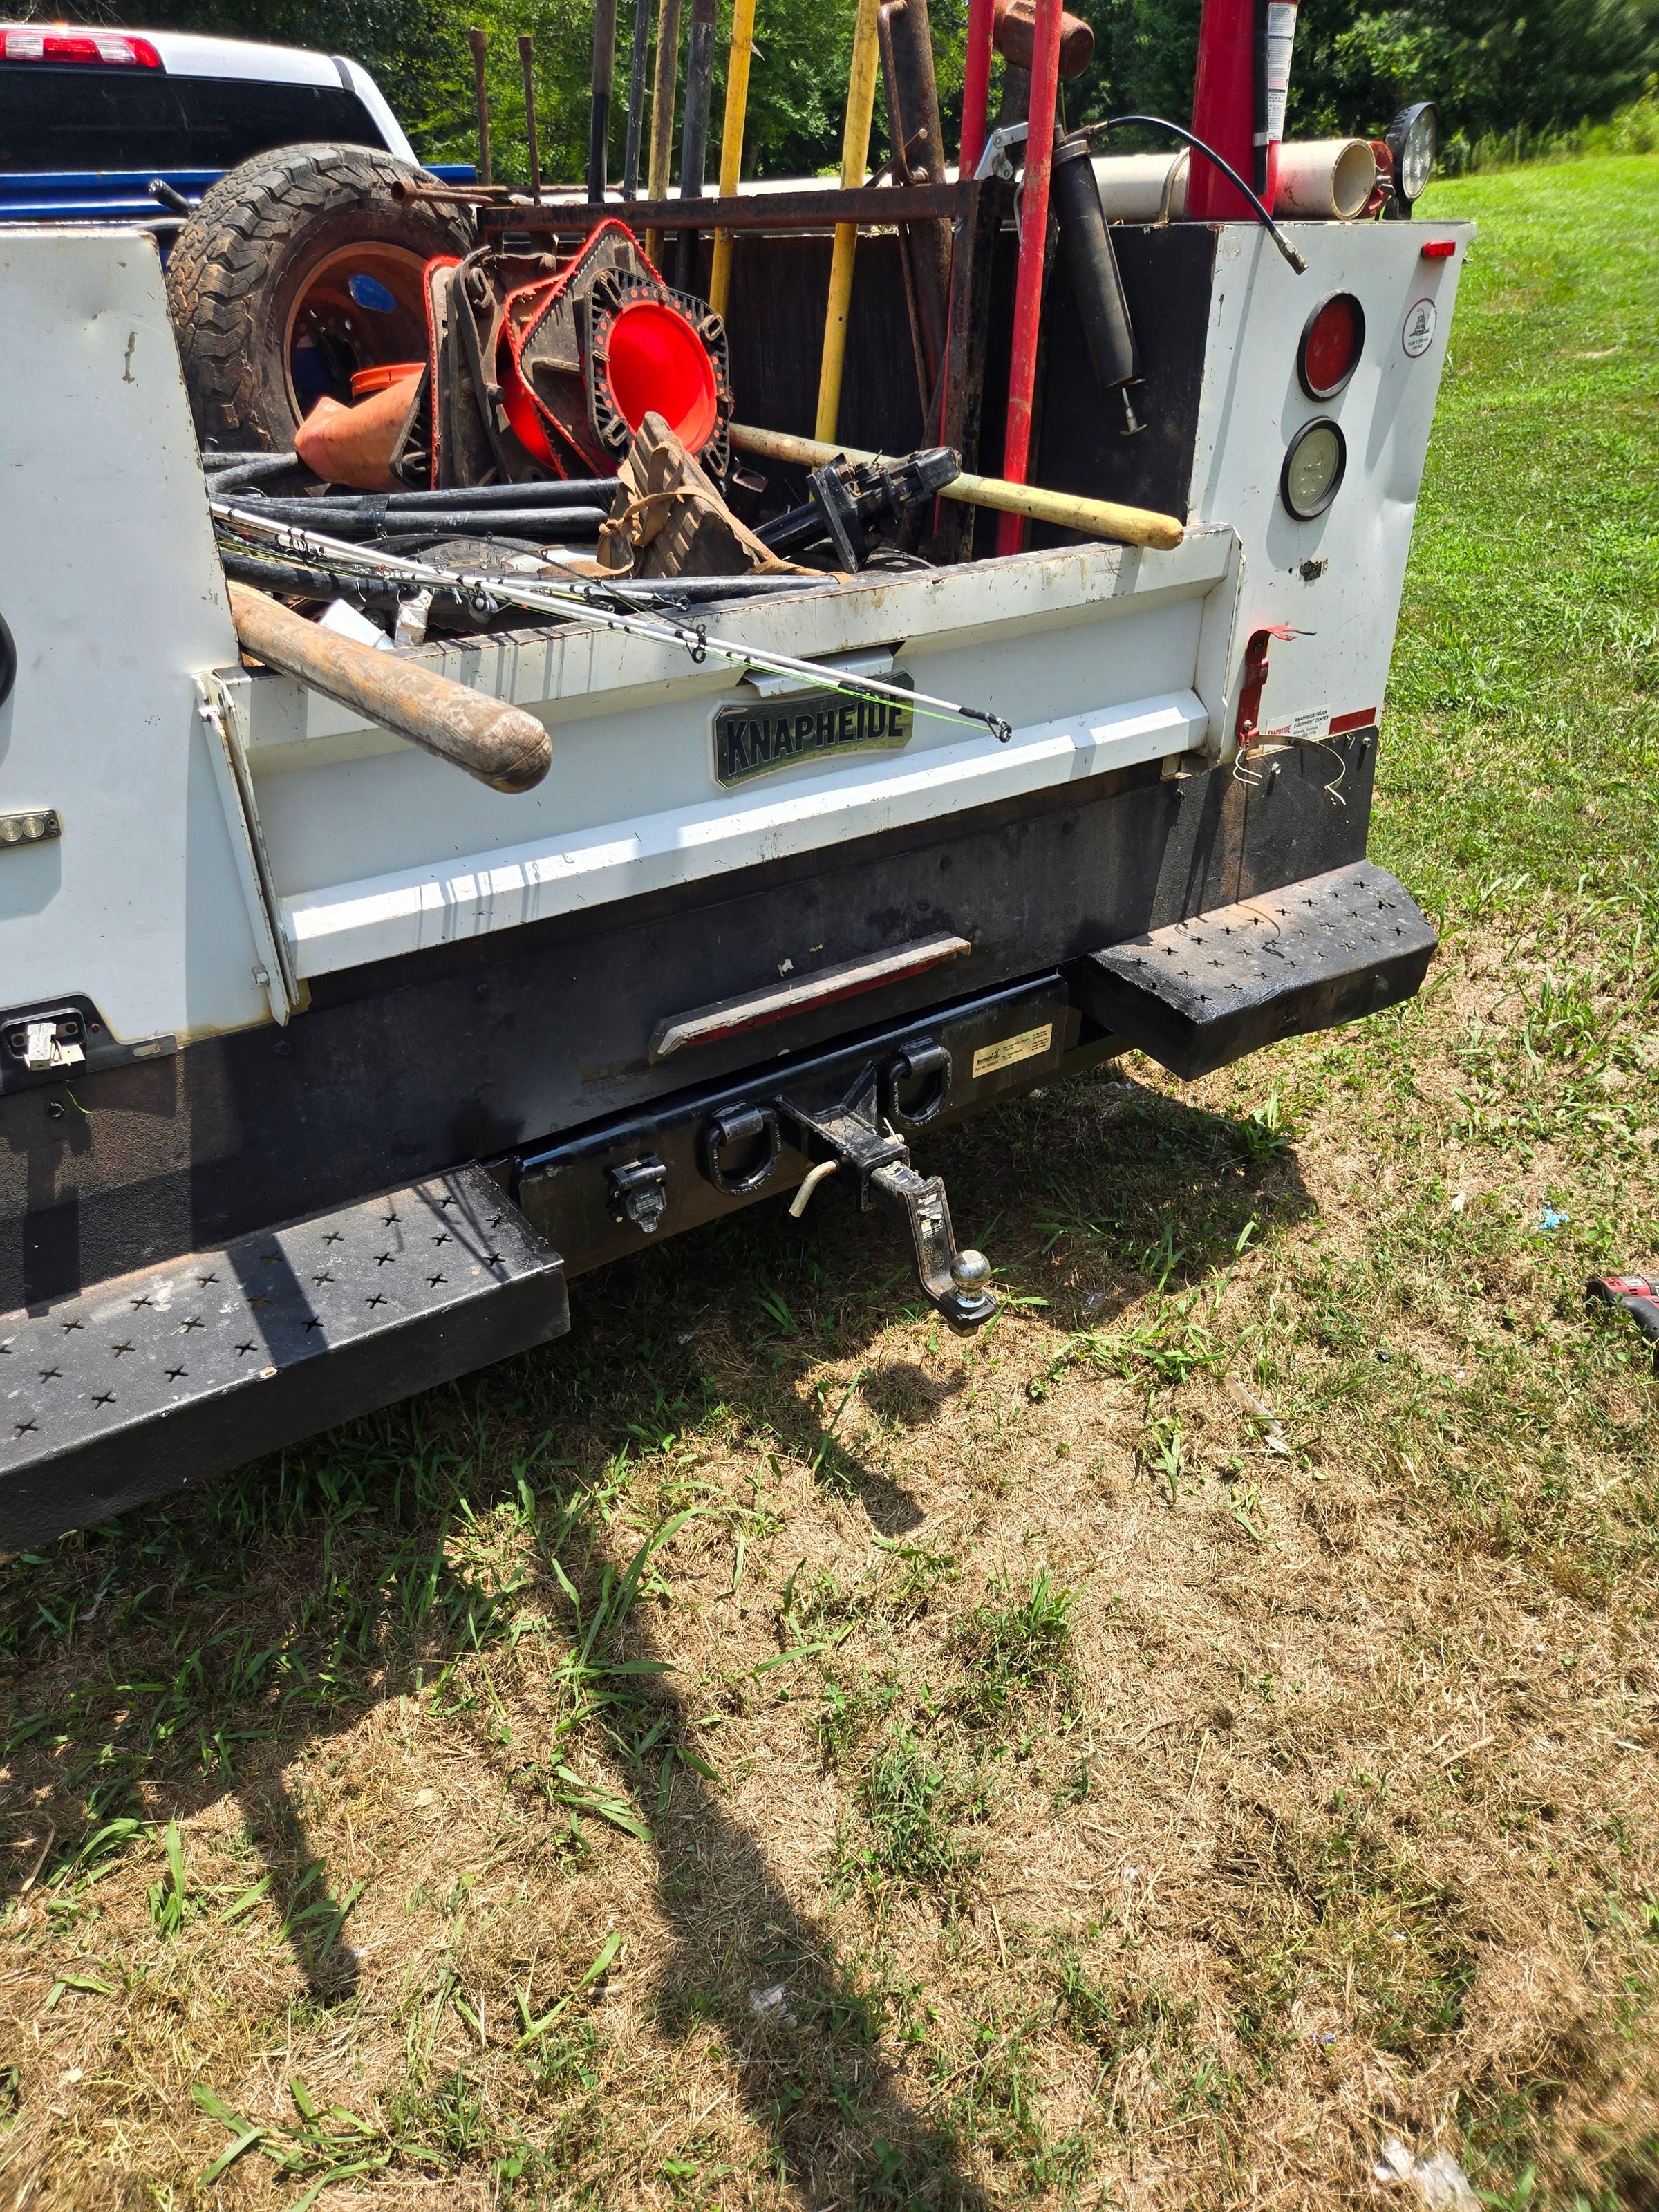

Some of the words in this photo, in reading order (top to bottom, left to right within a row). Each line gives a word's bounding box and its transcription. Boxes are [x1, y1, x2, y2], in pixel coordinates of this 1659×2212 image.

[1293, 719, 1314, 728] EQUIPMENT
[1315, 715, 1329, 723] CENTER
[1295, 713, 1315, 722] KNAPHEIDE
[727, 693, 903, 776] KNAPHEIDE
